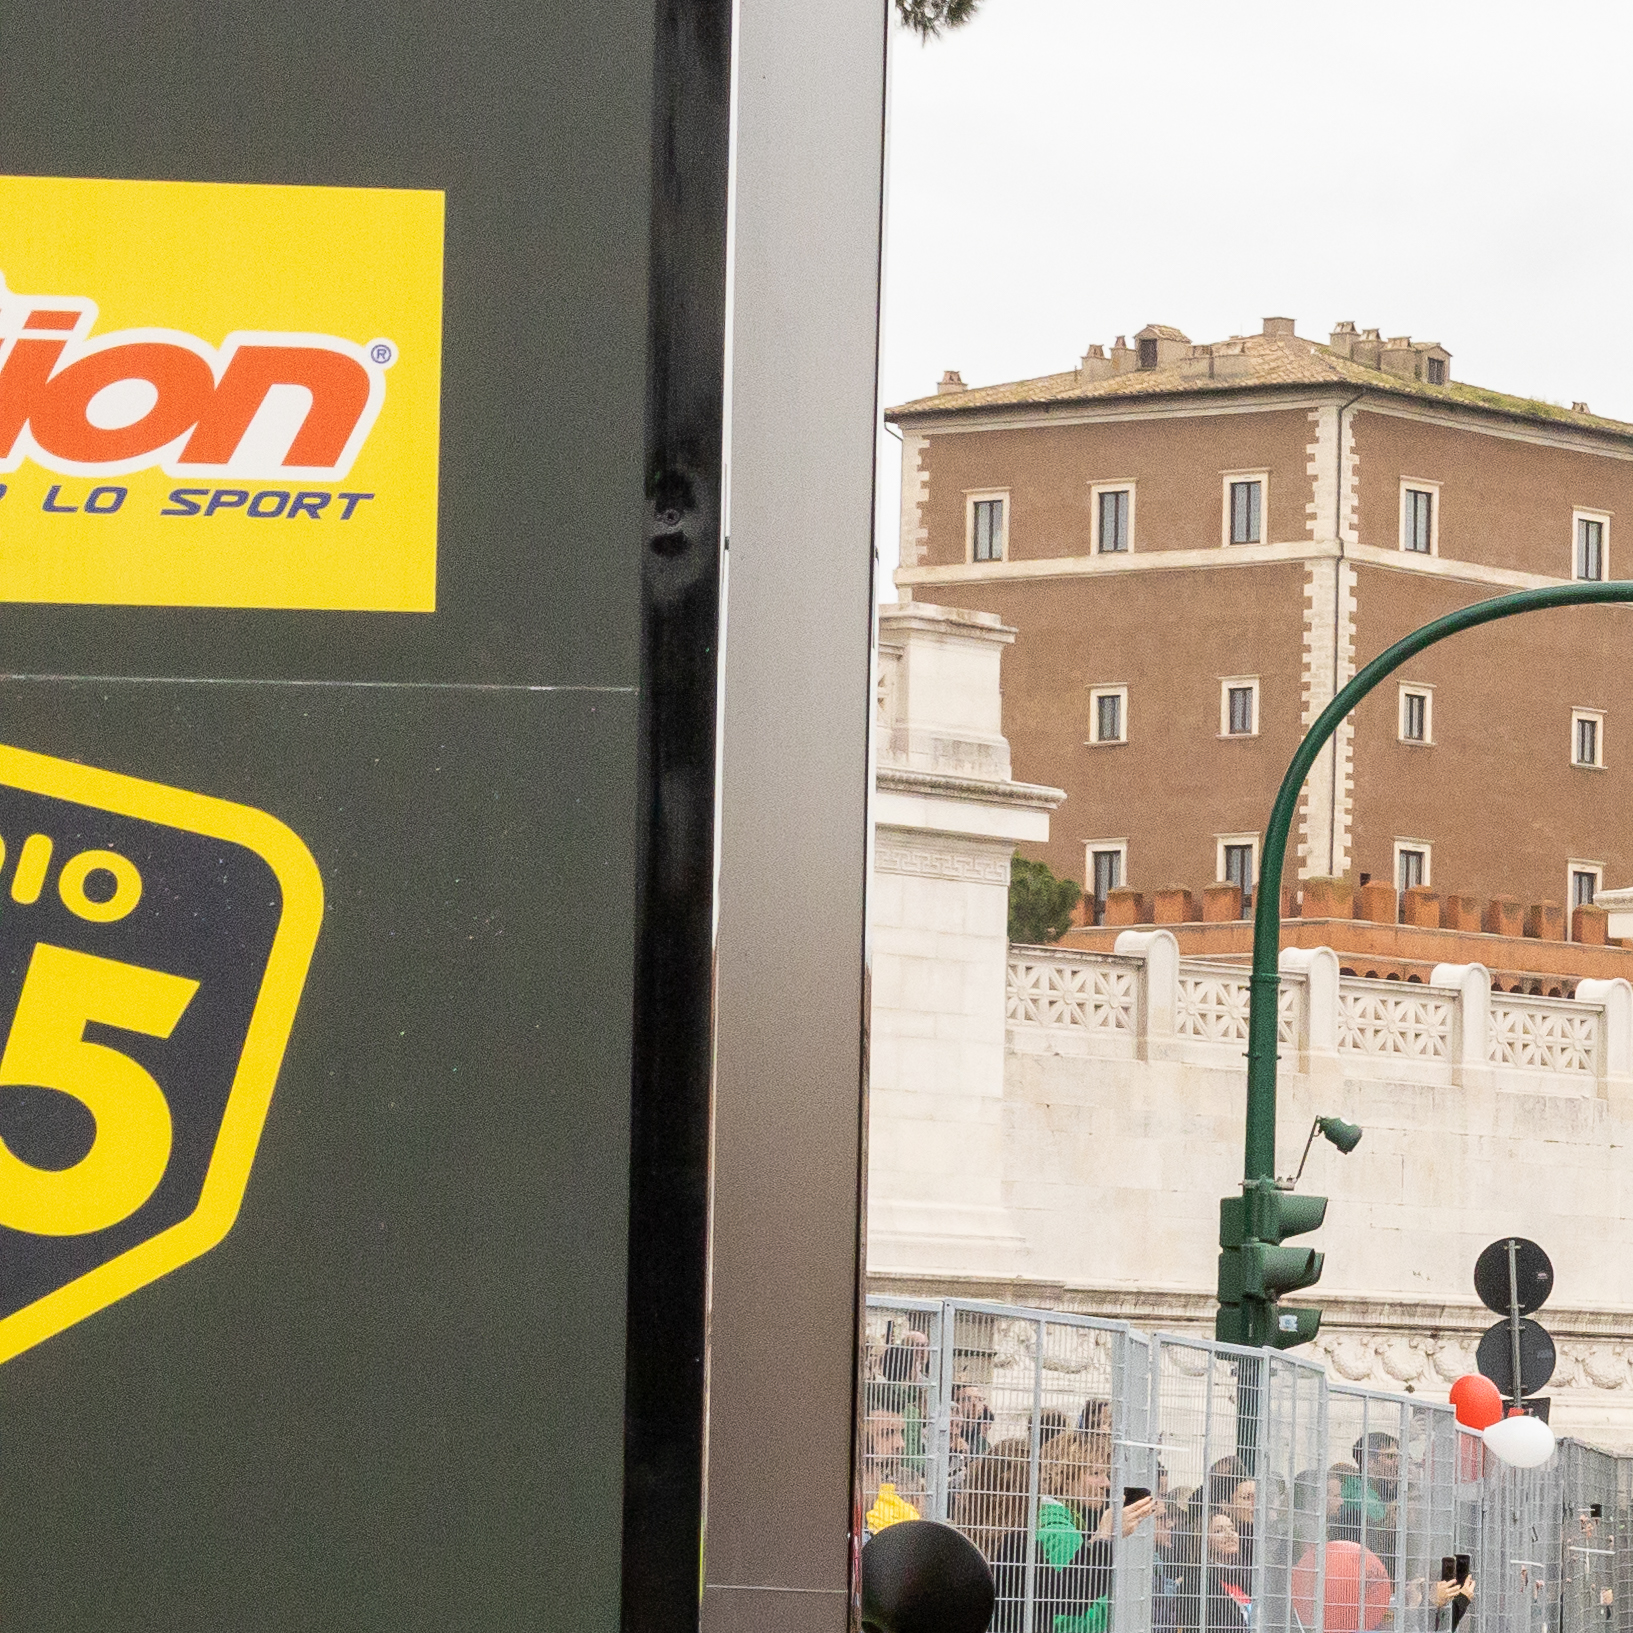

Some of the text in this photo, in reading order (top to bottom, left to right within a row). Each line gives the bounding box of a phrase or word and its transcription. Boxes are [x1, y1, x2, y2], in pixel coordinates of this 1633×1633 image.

[0, 306, 371, 468] ion
[41, 485, 128, 514] LO
[160, 488, 376, 521] SPORT
[0, 832, 143, 923] IO
